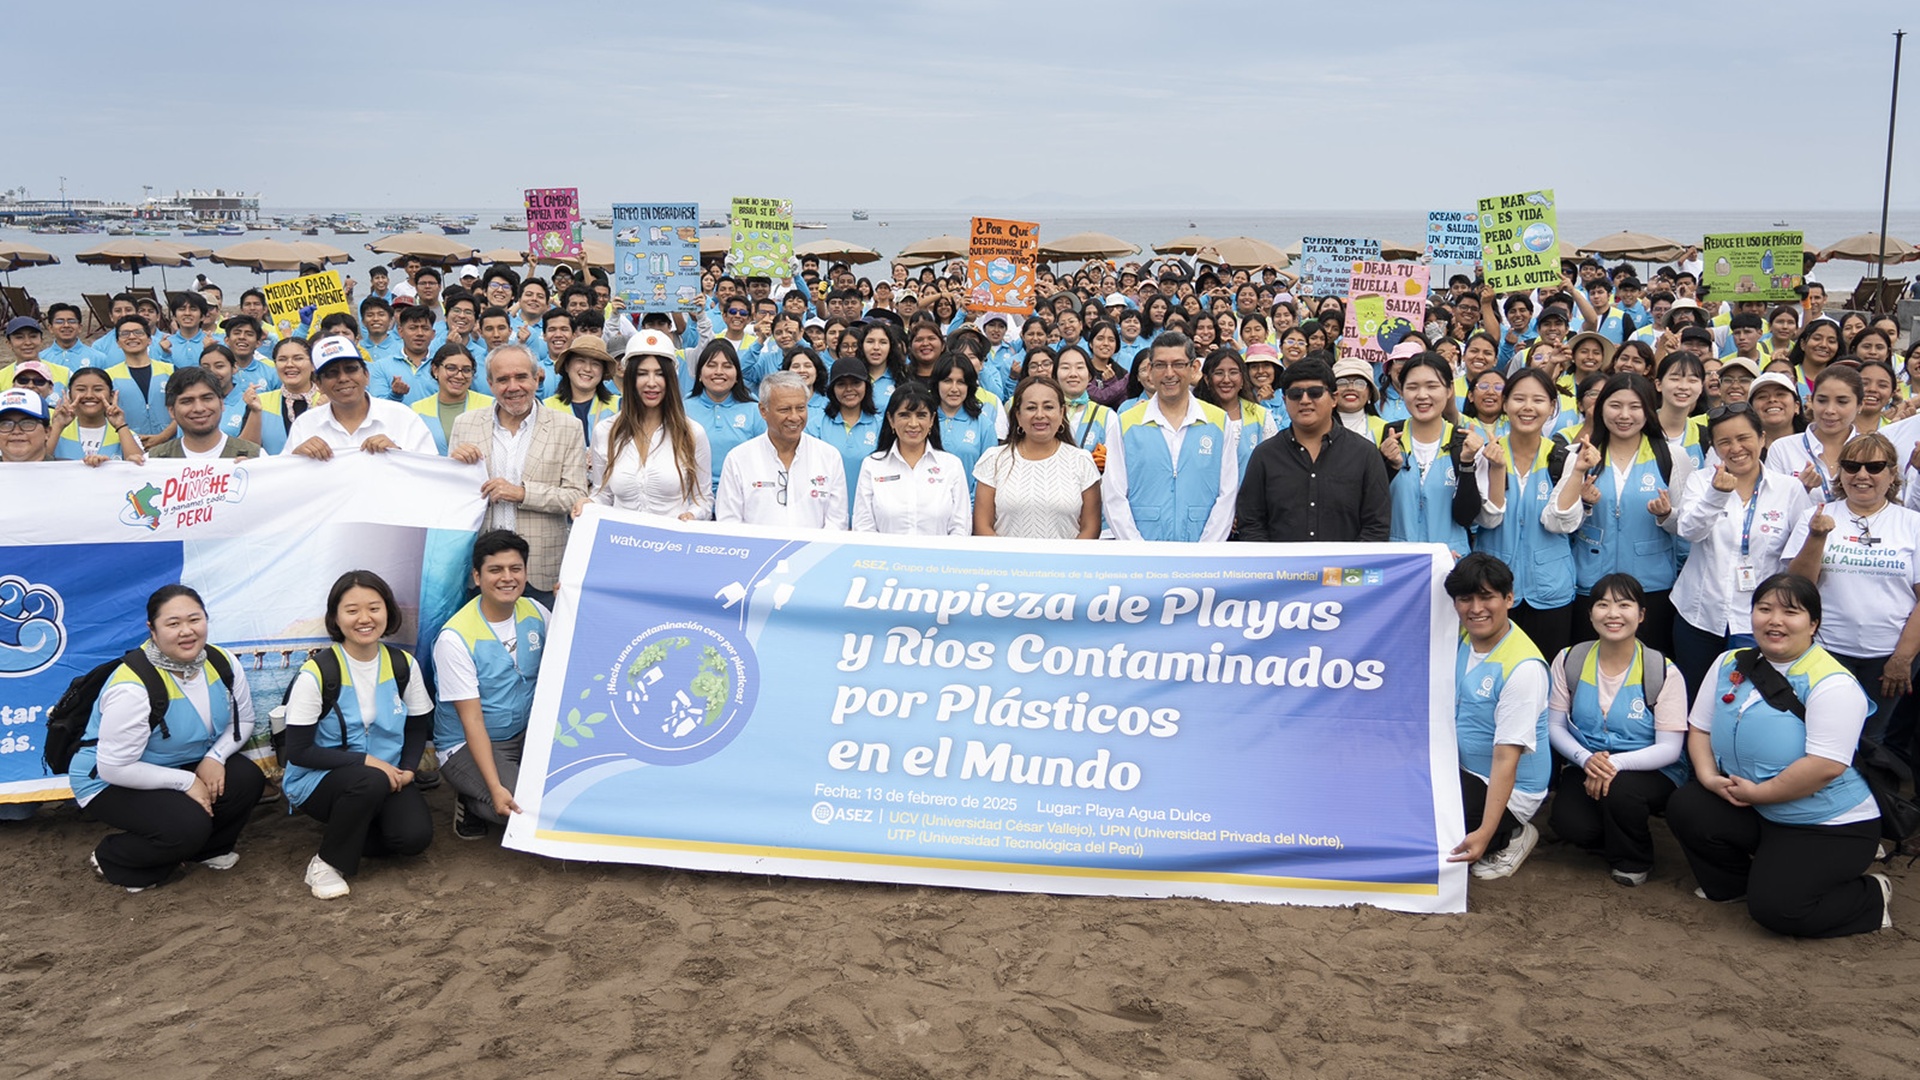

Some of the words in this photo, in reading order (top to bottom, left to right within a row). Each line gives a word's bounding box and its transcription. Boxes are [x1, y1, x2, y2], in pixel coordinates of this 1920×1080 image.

[529, 195, 542, 208] EL
[544, 194, 572, 207] CAMBIO
[761, 198, 770, 206] SEA
[771, 199, 779, 207] TU
[1480, 199, 1494, 211] EL
[1501, 194, 1525, 209] MAR
[527, 208, 551, 220] EMPIEZA
[555, 208, 568, 219] POR
[613, 206, 639, 220] TIEMPO
[641, 207, 651, 220] EN
[653, 207, 695, 220] DEGRADARSE
[760, 208, 766, 216] SI
[769, 208, 776, 216] ES
[1429, 212, 1461, 222] OCEANO
[1498, 211, 1512, 224] ES
[1517, 208, 1544, 221] VIDA
[537, 221, 567, 231] NOSOTROS
[742, 218, 753, 228] TU
[756, 220, 789, 231] PROBLEMA
[1447, 223, 1480, 233] SALUDA
[1303, 236, 1356, 246] CUIDEMOS
[1429, 235, 1440, 244] UN
[1445, 235, 1478, 246] FUTURO
[1485, 228, 1513, 243] PERO
[1704, 236, 1735, 250] REDUCE
[1736, 237, 1745, 248] EL
[1746, 236, 1761, 247] USO
[1762, 236, 1771, 247] DE
[969, 247, 982, 256] QUE
[996, 248, 1023, 256] MANTIENE
[1020, 240, 1029, 249] LO
[1306, 245, 1338, 253] PLAYA
[1345, 246, 1379, 256] ENTRE
[1497, 243, 1512, 256] LA
[1009, 254, 1036, 269] VIVOS?
[1332, 254, 1364, 262] TODOS
[1495, 254, 1541, 271] BASURA
[1364, 261, 1392, 276] DEJA
[1398, 264, 1414, 277] TU
[265, 281, 303, 300] MEDIDAS
[305, 275, 336, 293] PARA
[1352, 278, 1398, 294] HUELLA
[1487, 277, 1503, 289] SE
[1506, 275, 1521, 287] LA
[1524, 270, 1557, 284] QUITA
[268, 301, 285, 315] UN
[285, 295, 307, 312] BUEN
[308, 289, 345, 307] AMBIENTE
[1386, 299, 1421, 315] SALVA
[1344, 326, 1359, 338] EL
[1341, 347, 1388, 363] PLANETA
[182, 464, 214, 482] Ponle
[163, 507, 169, 516] y
[171, 499, 204, 515] ganamos
[206, 493, 227, 505] todos
[177, 505, 213, 529] PERÚ
[610, 534, 682, 553] watv.org/es
[695, 543, 750, 560] asez.org
[1828, 543, 1897, 557] Ministerio
[852, 559, 889, 571] ASEZ,
[892, 562, 923, 574] Grupo
[925, 564, 939, 573] de
[941, 566, 1008, 577] Universitarios
[1011, 568, 1066, 578] Voluntarios
[1068, 570, 1081, 579] de
[1084, 570, 1093, 579] la
[1095, 571, 1128, 581] Iglesia
[1130, 570, 1143, 579] de
[1146, 570, 1169, 579] Dios
[1172, 570, 1220, 579] Sociedad
[1223, 569, 1274, 580] Misionera
[1276, 570, 1318, 581] Mundial
[1839, 555, 1906, 570] Ambiente
[844, 576, 1074, 626] Limpieza
[1087, 585, 1150, 622] de
[1160, 587, 1343, 639] Playas
[617, 644, 633, 663] una
[631, 620, 703, 647] contaminación
[703, 625, 725, 643] cero
[720, 640, 737, 656] por
[730, 655, 747, 705] plásticos!
[837, 633, 874, 673] y
[882, 625, 995, 669] Ríos
[1007, 633, 1385, 690] Contaminados
[831, 685, 928, 725] por
[936, 684, 1181, 738] Plásticos
[828, 740, 891, 773] en
[902, 737, 953, 778] el
[960, 740, 1142, 791] Mundo
[815, 783, 861, 799] Fecha:
[866, 787, 883, 801] 13
[885, 789, 904, 803] de
[907, 791, 957, 807] febrero
[961, 795, 979, 808] de
[982, 796, 1017, 811] 2025
[1037, 800, 1081, 817] Lugar:
[1085, 804, 1125, 819] Playa
[1127, 807, 1166, 822] Agua
[1170, 809, 1211, 823] Dulce
[835, 808, 873, 823] ASEZ
[889, 811, 919, 825] UCV
[922, 812, 1002, 831] (Universidad
[1006, 814, 1045, 833] César
[1047, 820, 1096, 838] Vallejo),
[1099, 825, 1130, 837] UPN
[1133, 826, 1217, 842] (Universidad
[1220, 830, 1271, 844] Privada
[1274, 833, 1295, 845] del
[1299, 834, 1344, 849] Norte),
[887, 828, 916, 841] UTP
[918, 830, 1000, 848] (Universidad
[1003, 835, 1082, 854] Tecnológica
[1085, 842, 1105, 854] del
[1109, 842, 1144, 858] Perú)
